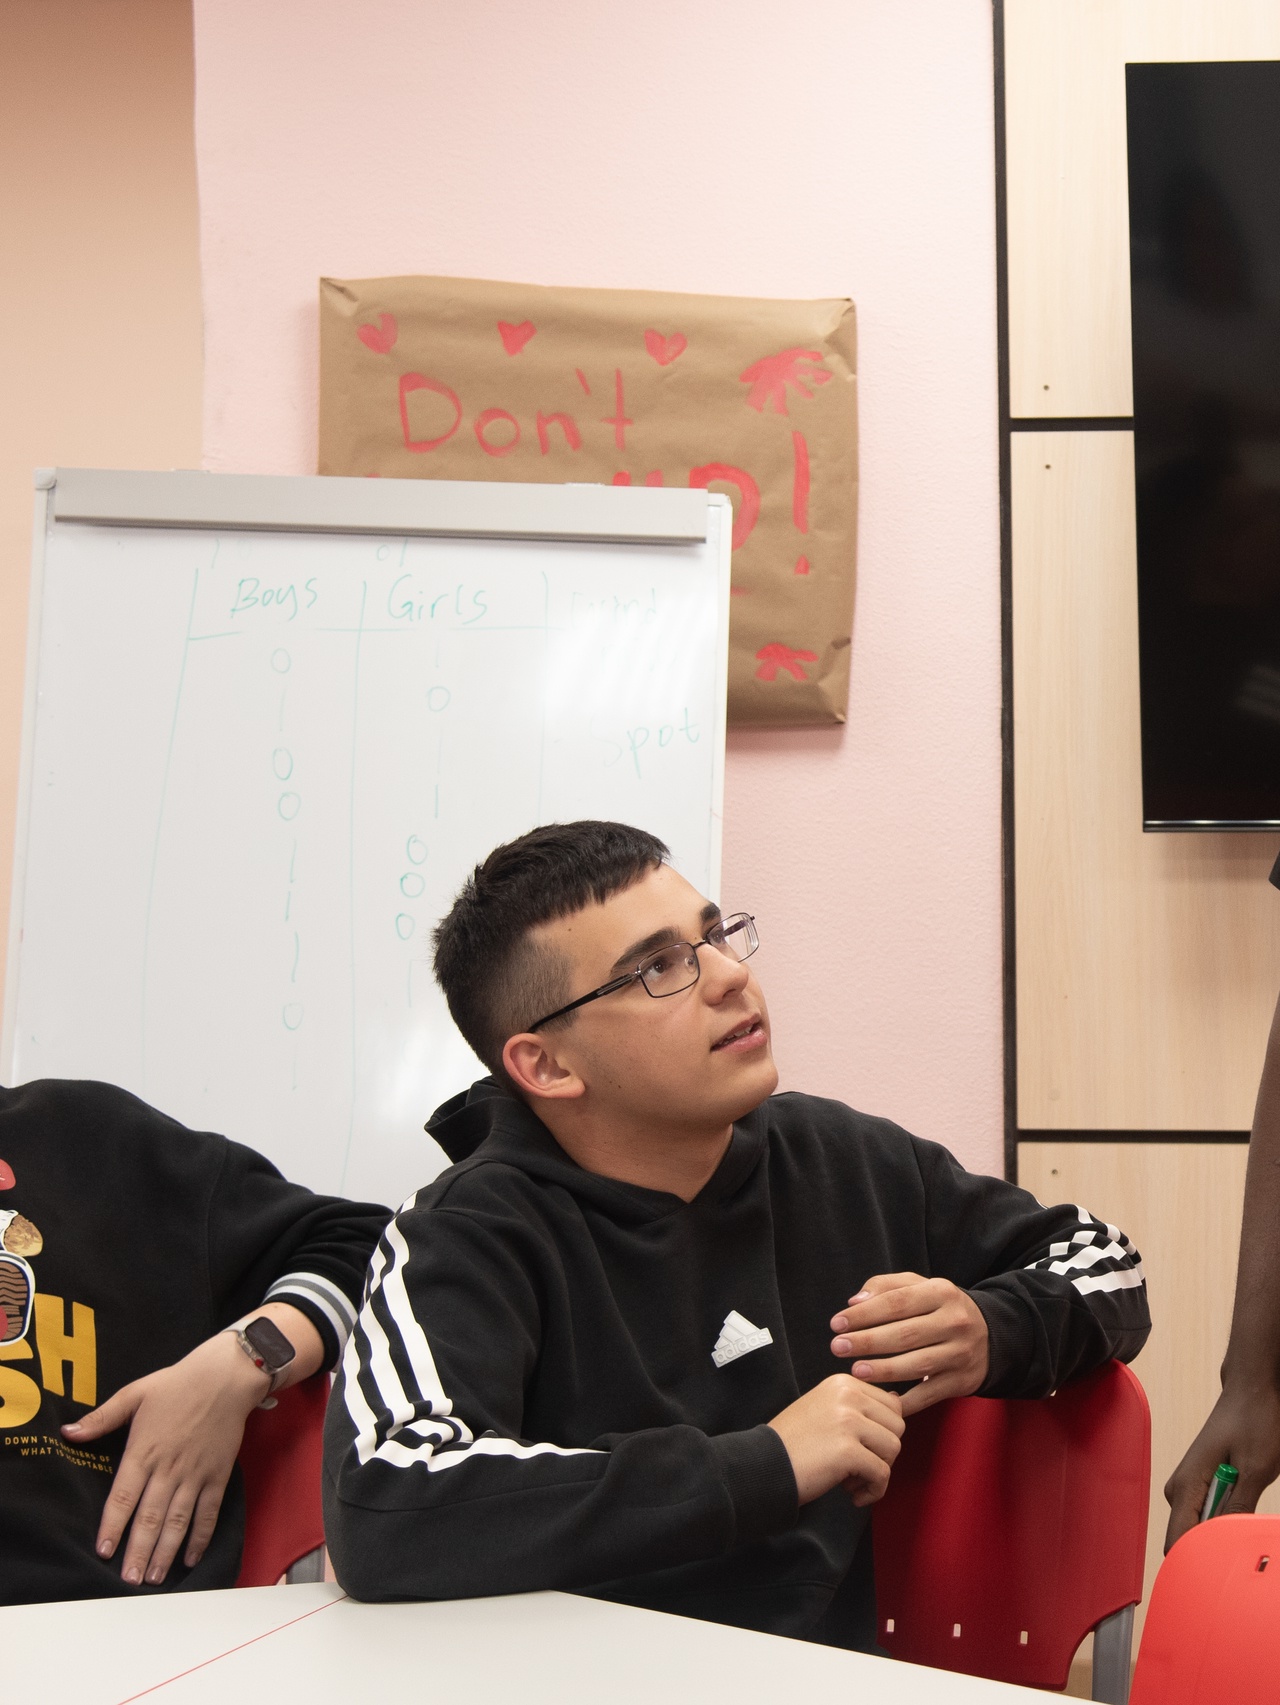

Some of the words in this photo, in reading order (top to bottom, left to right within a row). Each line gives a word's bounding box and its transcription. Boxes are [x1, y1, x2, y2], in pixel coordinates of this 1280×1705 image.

[400, 369, 633, 456] Don't
[230, 577, 318, 622] Boys
[388, 574, 488, 625] Girls
[715, 1331, 769, 1364] adidas
[4, 1435, 39, 1446] DOWN
[43, 1435, 60, 1447] THE
[99, 1455, 111, 1463] OF
[21, 1446, 52, 1457] WHAT
[56, 1448, 65, 1458] IS
